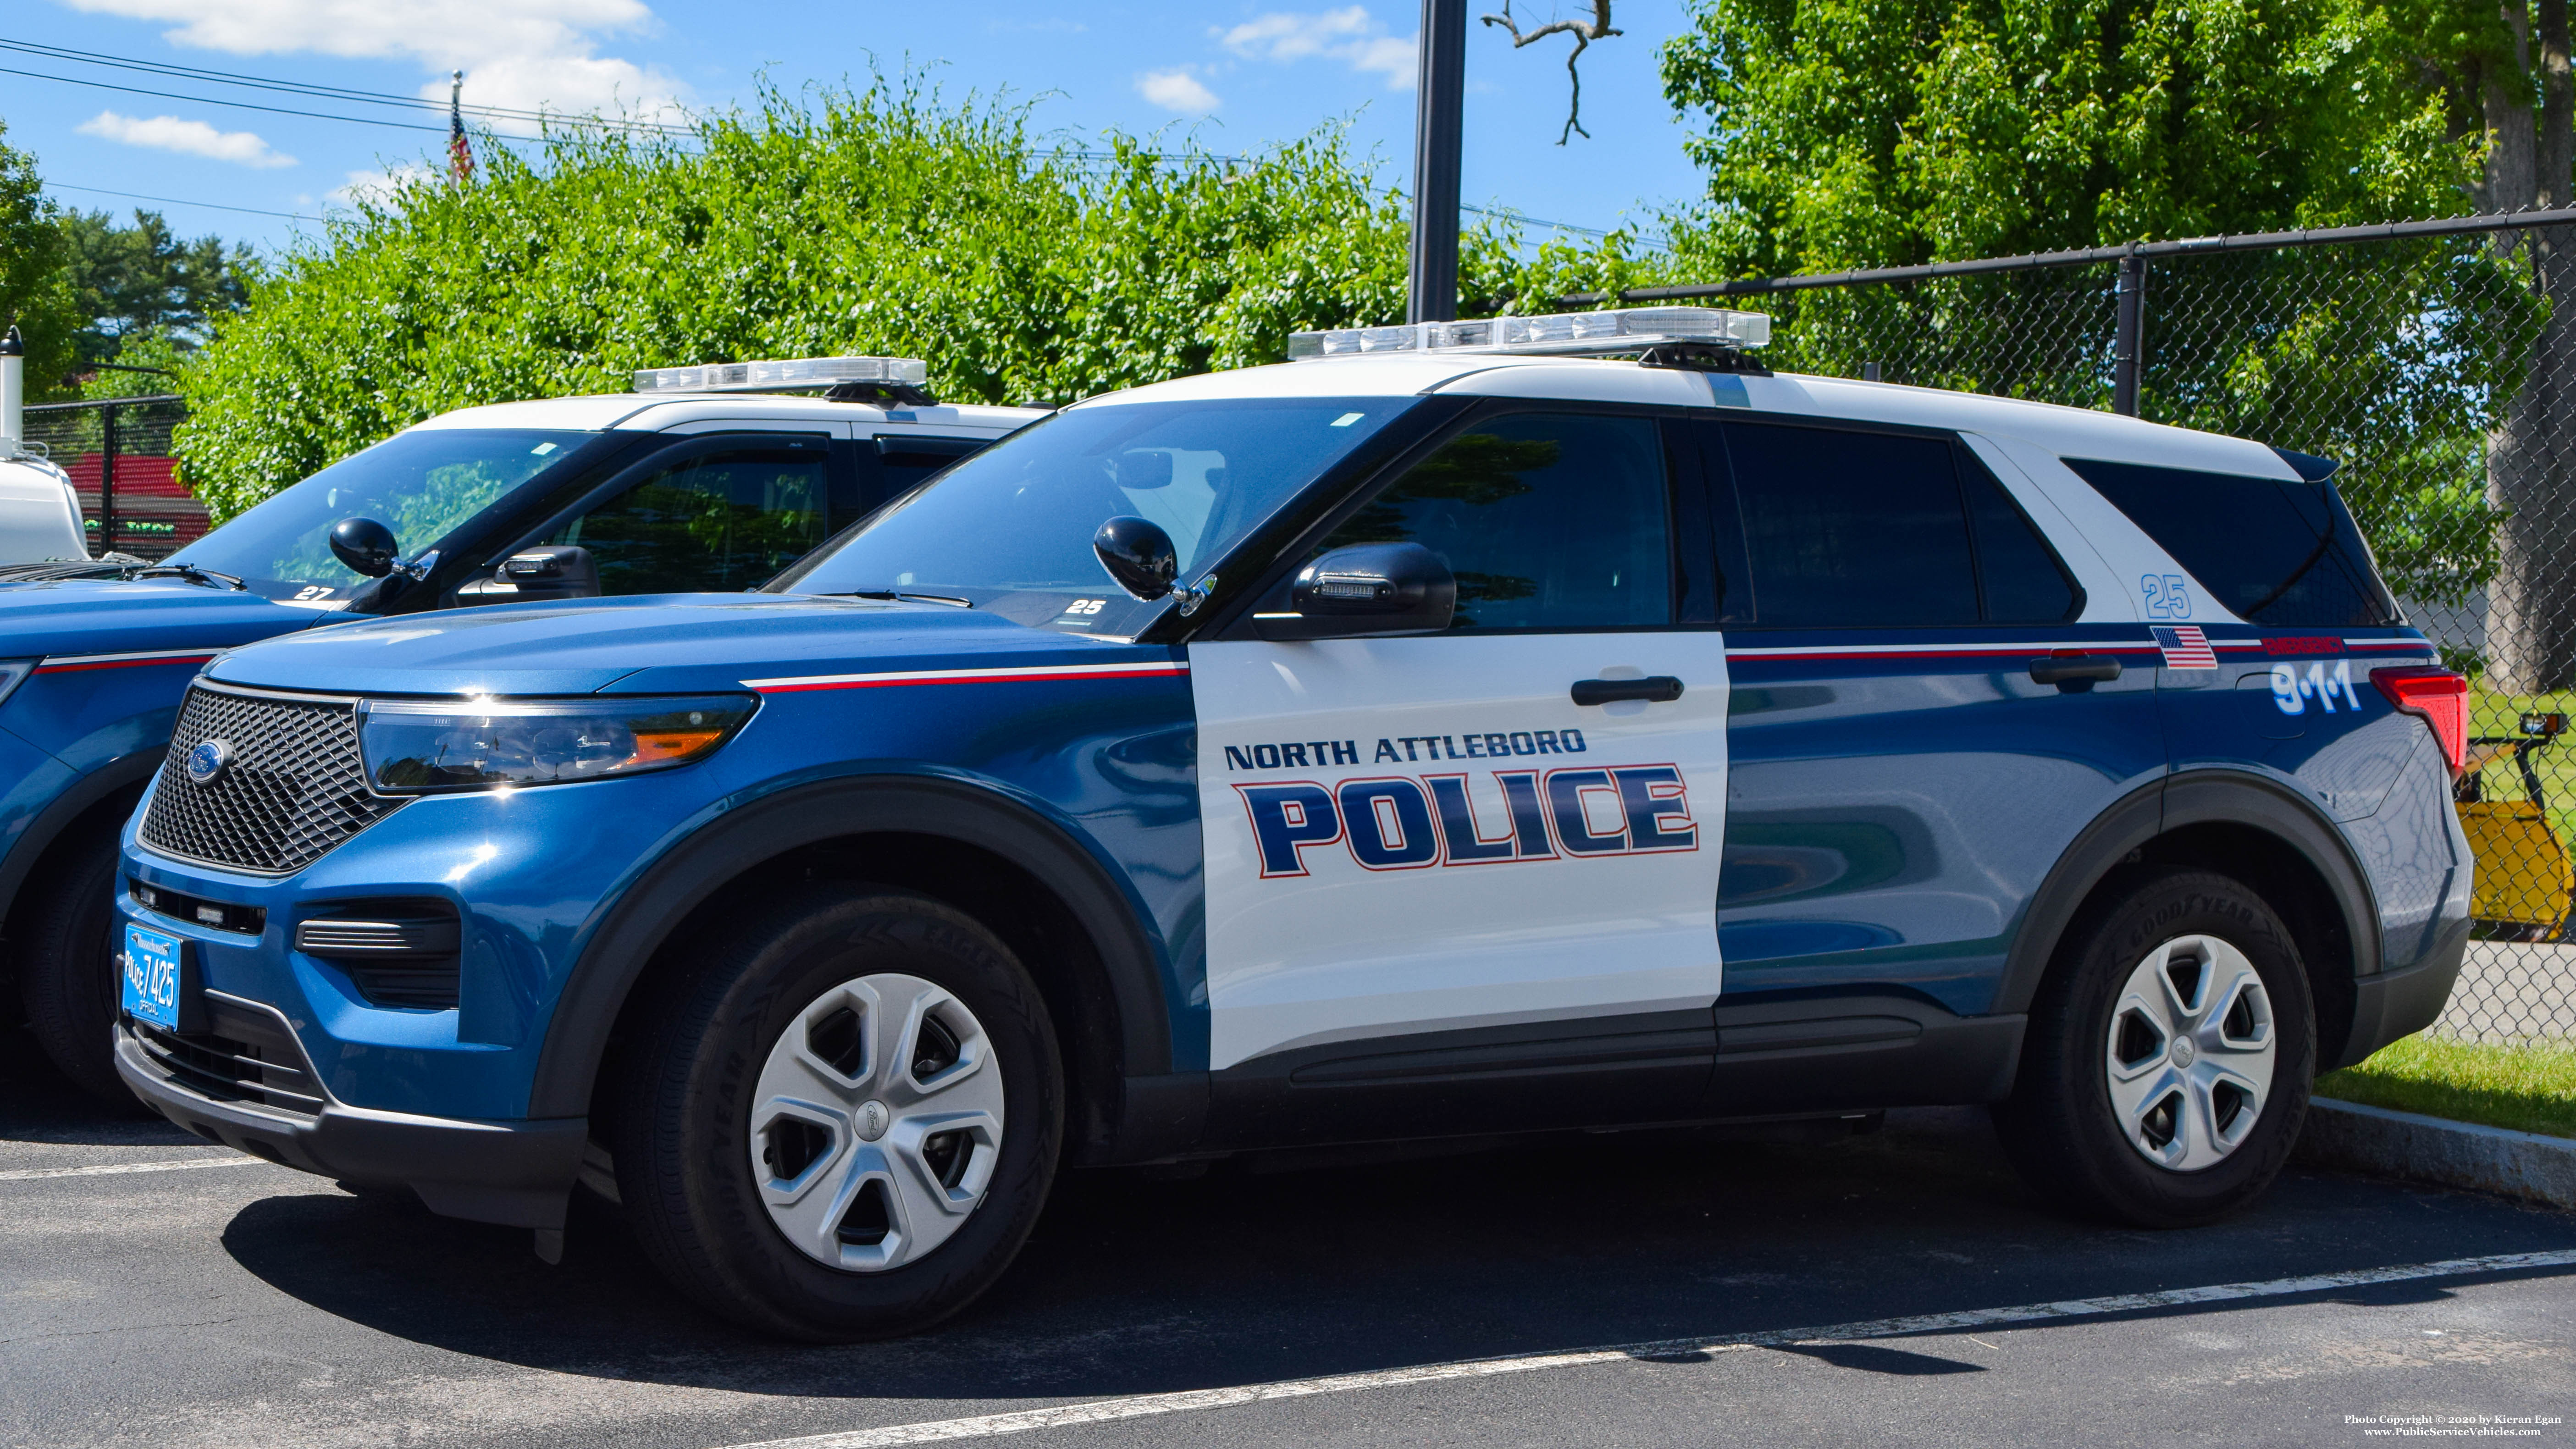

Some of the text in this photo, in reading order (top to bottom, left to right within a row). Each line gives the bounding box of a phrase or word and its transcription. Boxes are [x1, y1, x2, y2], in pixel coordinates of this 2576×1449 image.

[294, 586, 335, 601] 27
[1065, 599, 1106, 614] 25
[2141, 574, 2191, 619] 25
[2261, 636, 2346, 656] EMERGENCY
[1224, 729, 1587, 771] NORTH ATTLEBORO
[1230, 762, 1699, 879] POLICE
[126, 950, 175, 1007] POLICE 7425
[139, 1000, 159, 1016] OFFICIAL
